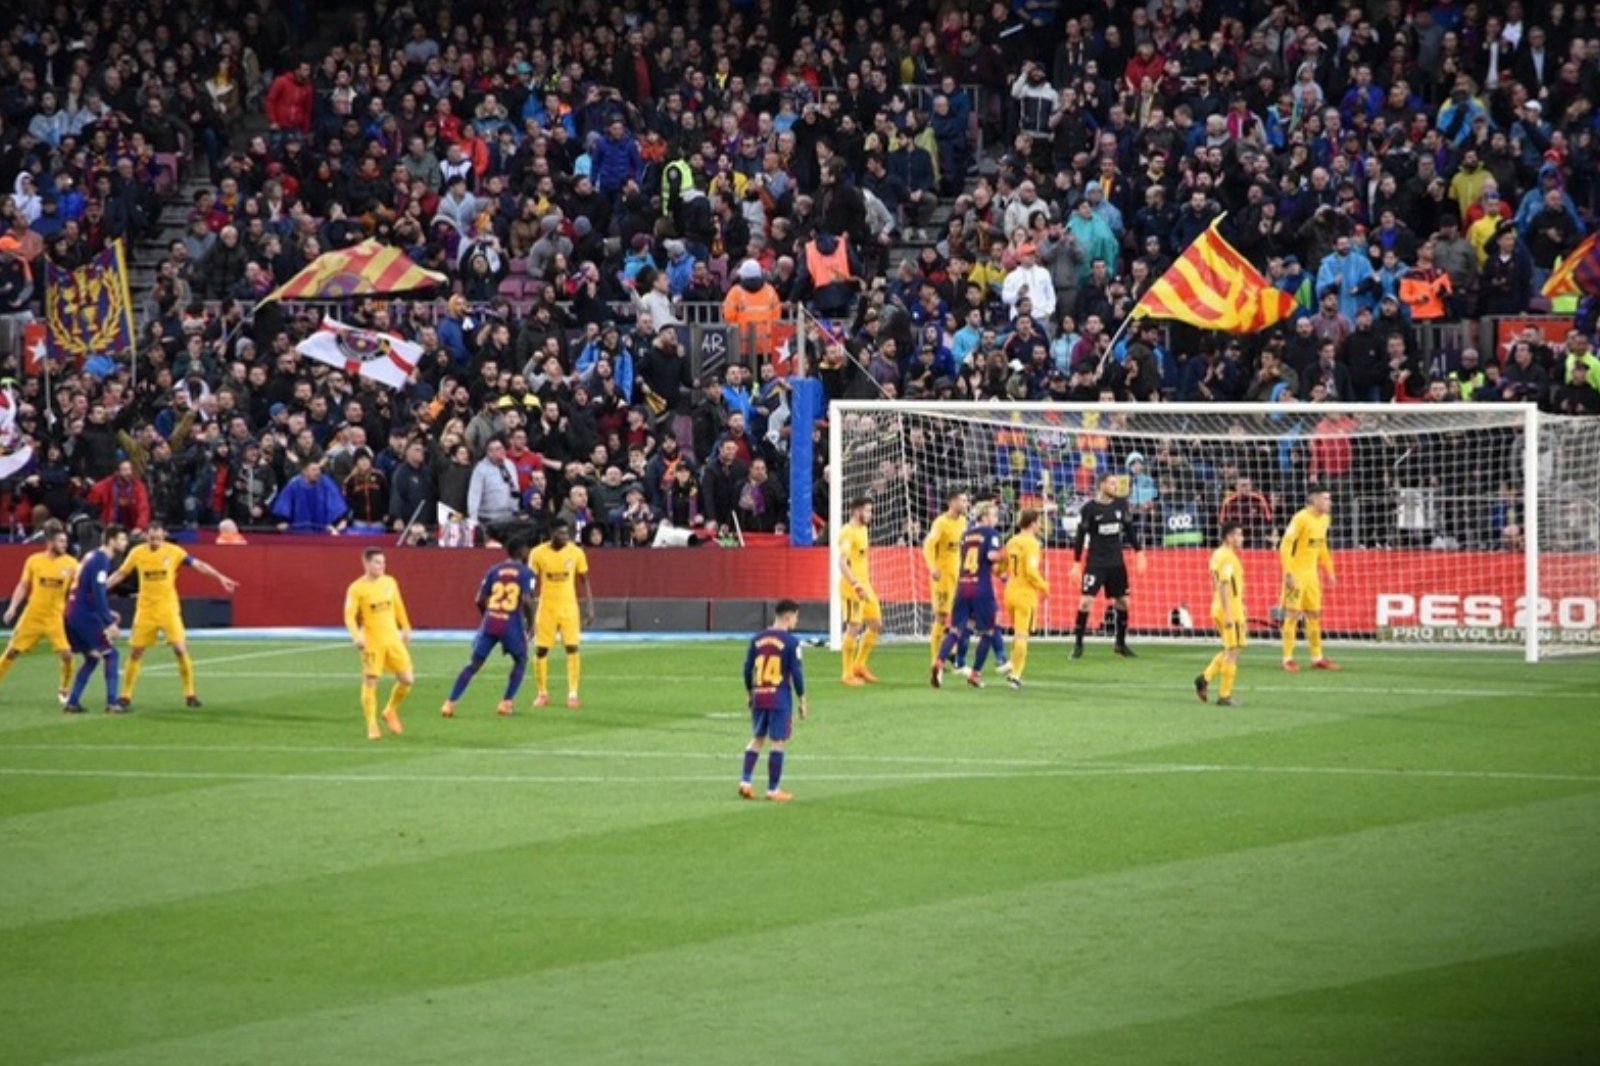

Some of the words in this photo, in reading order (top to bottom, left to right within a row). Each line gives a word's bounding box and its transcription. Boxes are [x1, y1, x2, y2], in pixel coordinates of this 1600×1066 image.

[963, 545, 979, 574] 4
[489, 581, 520, 611] 23
[1376, 594, 1502, 627] PES
[1392, 627, 1434, 640] PRO
[754, 654, 783, 687] 14
